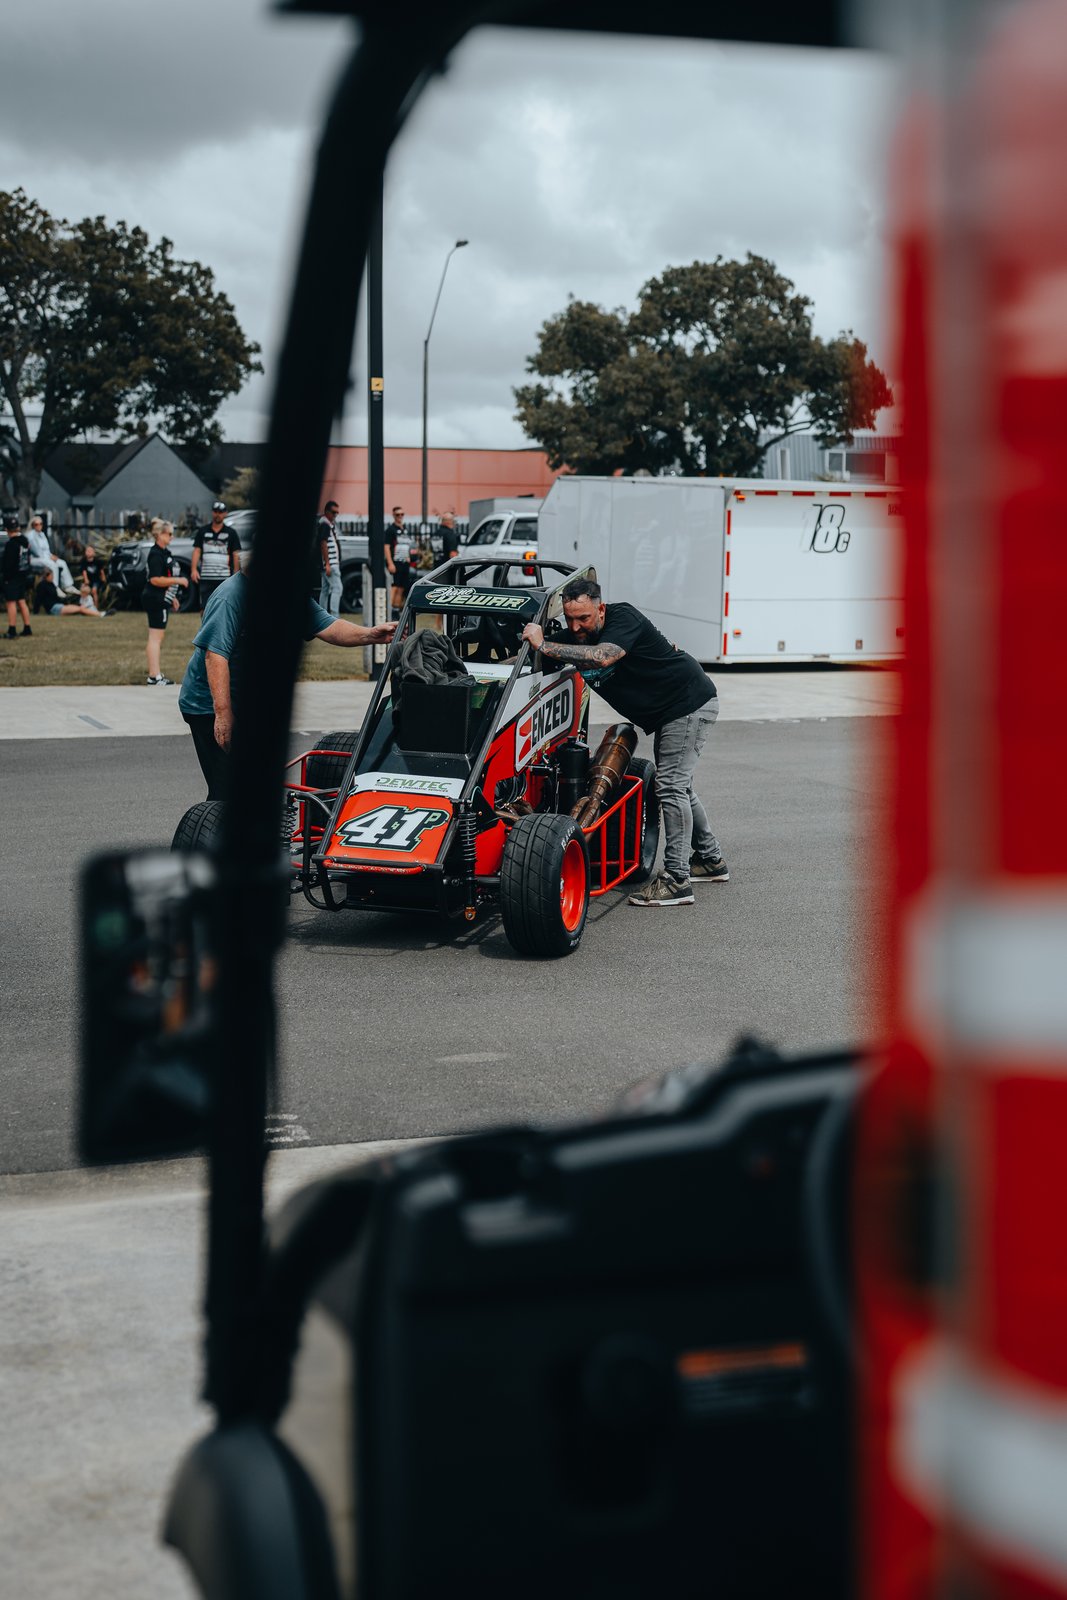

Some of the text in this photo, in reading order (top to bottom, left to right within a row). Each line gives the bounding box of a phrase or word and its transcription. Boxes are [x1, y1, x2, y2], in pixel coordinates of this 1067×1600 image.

[433, 593, 526, 608] DEWAR
[531, 688, 570, 748] ENZED
[377, 777, 452, 790] DEWTEC
